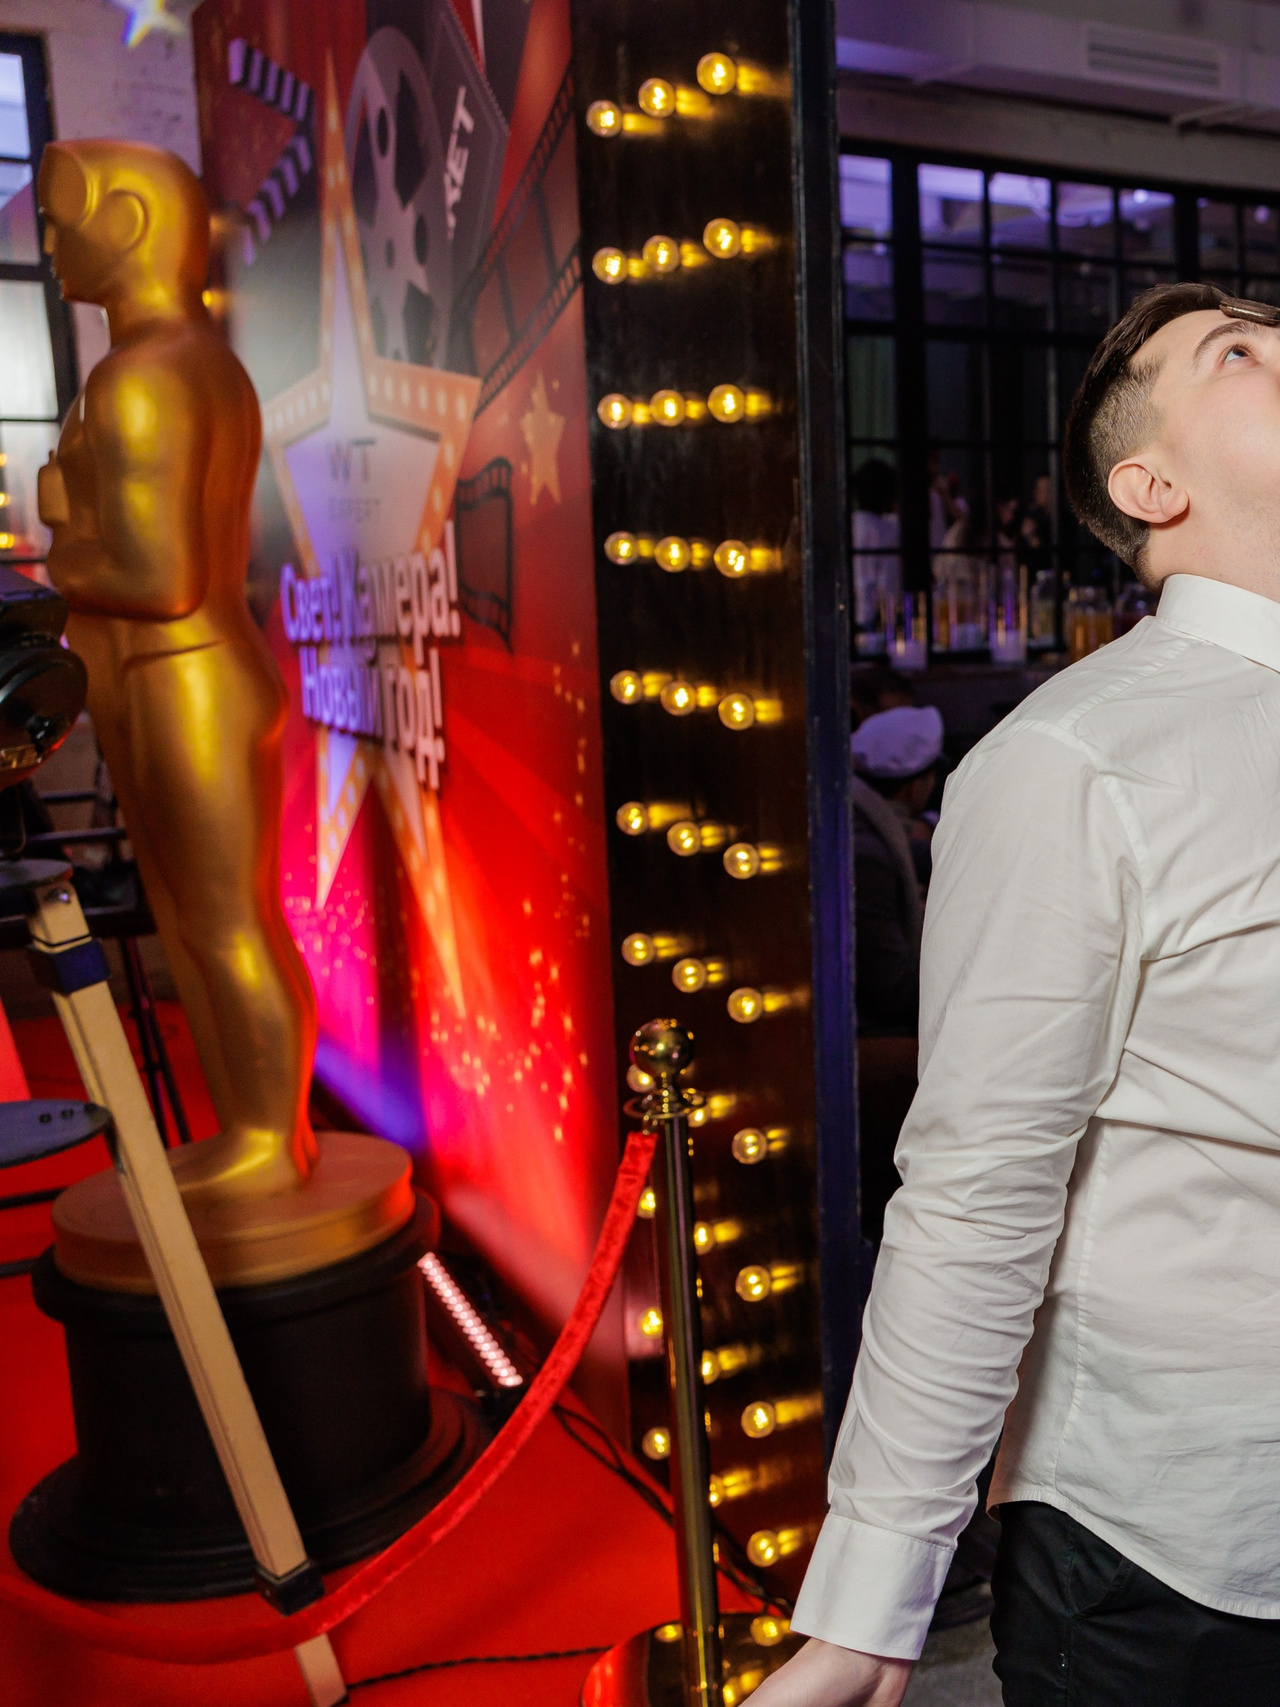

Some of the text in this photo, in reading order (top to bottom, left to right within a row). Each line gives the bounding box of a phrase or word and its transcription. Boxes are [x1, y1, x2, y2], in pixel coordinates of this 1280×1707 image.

[443, 86, 474, 240] KET
[326, 438, 376, 482] WT
[280, 519, 461, 666] Свет! Камера!
[299, 638, 384, 740] Новый
